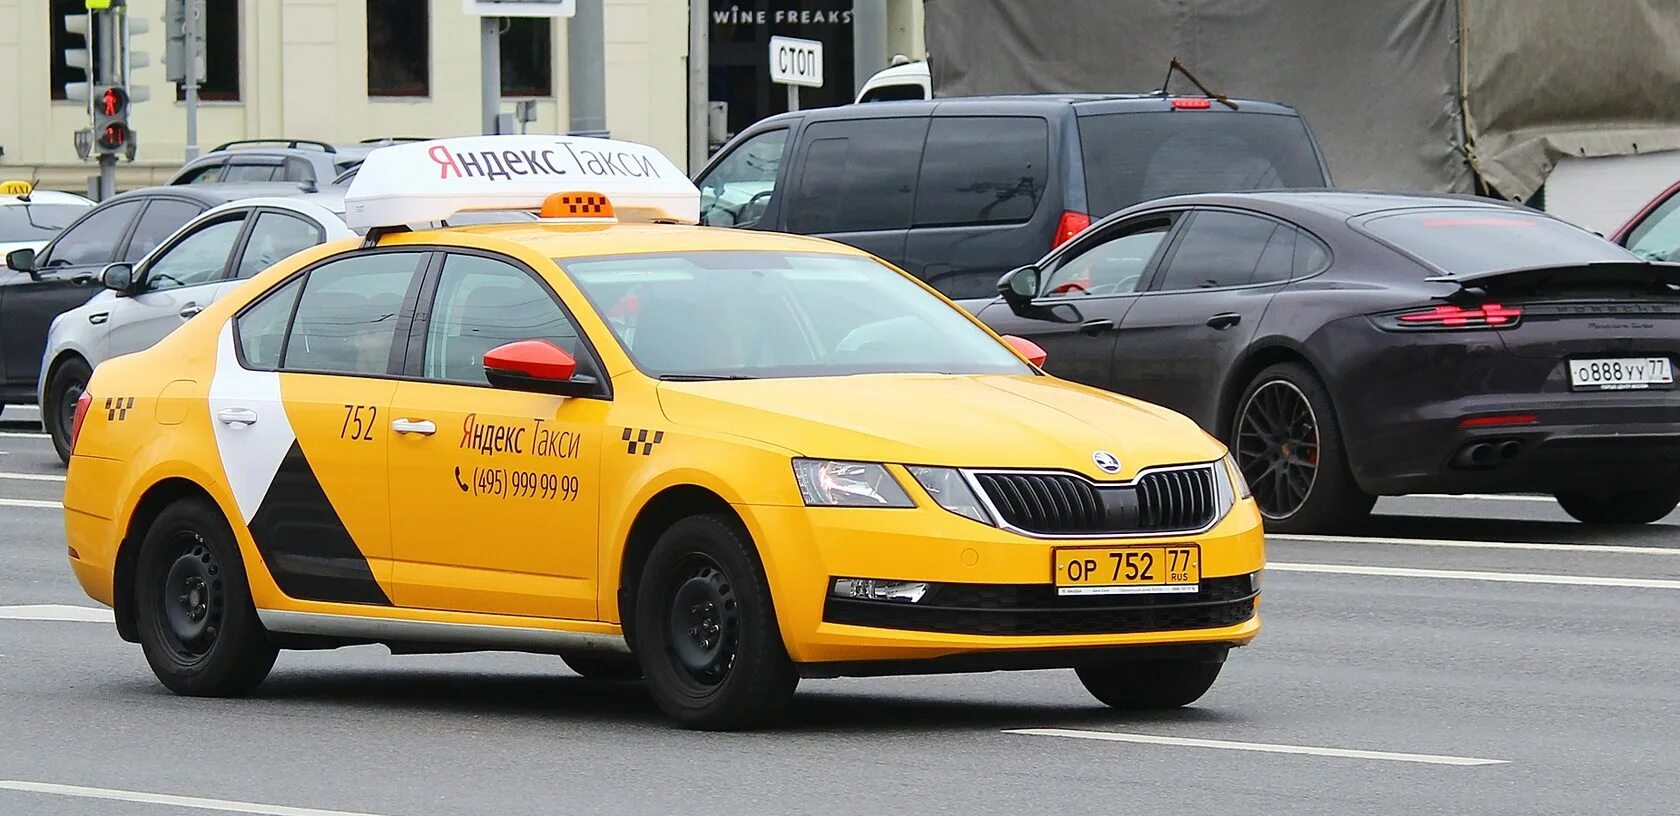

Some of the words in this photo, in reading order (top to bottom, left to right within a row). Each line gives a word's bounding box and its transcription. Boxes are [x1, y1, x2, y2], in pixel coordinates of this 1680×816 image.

[775, 10, 852, 24] FREAKS
[779, 45, 816, 77] СТОП
[428, 145, 567, 181] Яндекс
[555, 141, 661, 179] Такси
[1649, 360, 1664, 375] 77
[340, 404, 377, 441] 752
[459, 413, 526, 456] Яндекс
[531, 418, 581, 460] Такси
[473, 466, 508, 500] (495)
[511, 470, 538, 498] 999
[540, 473, 558, 500] 99
[561, 475, 580, 502] 99
[1109, 552, 1154, 581] 752
[1168, 550, 1190, 572] 77
[1171, 572, 1189, 581] RUS
